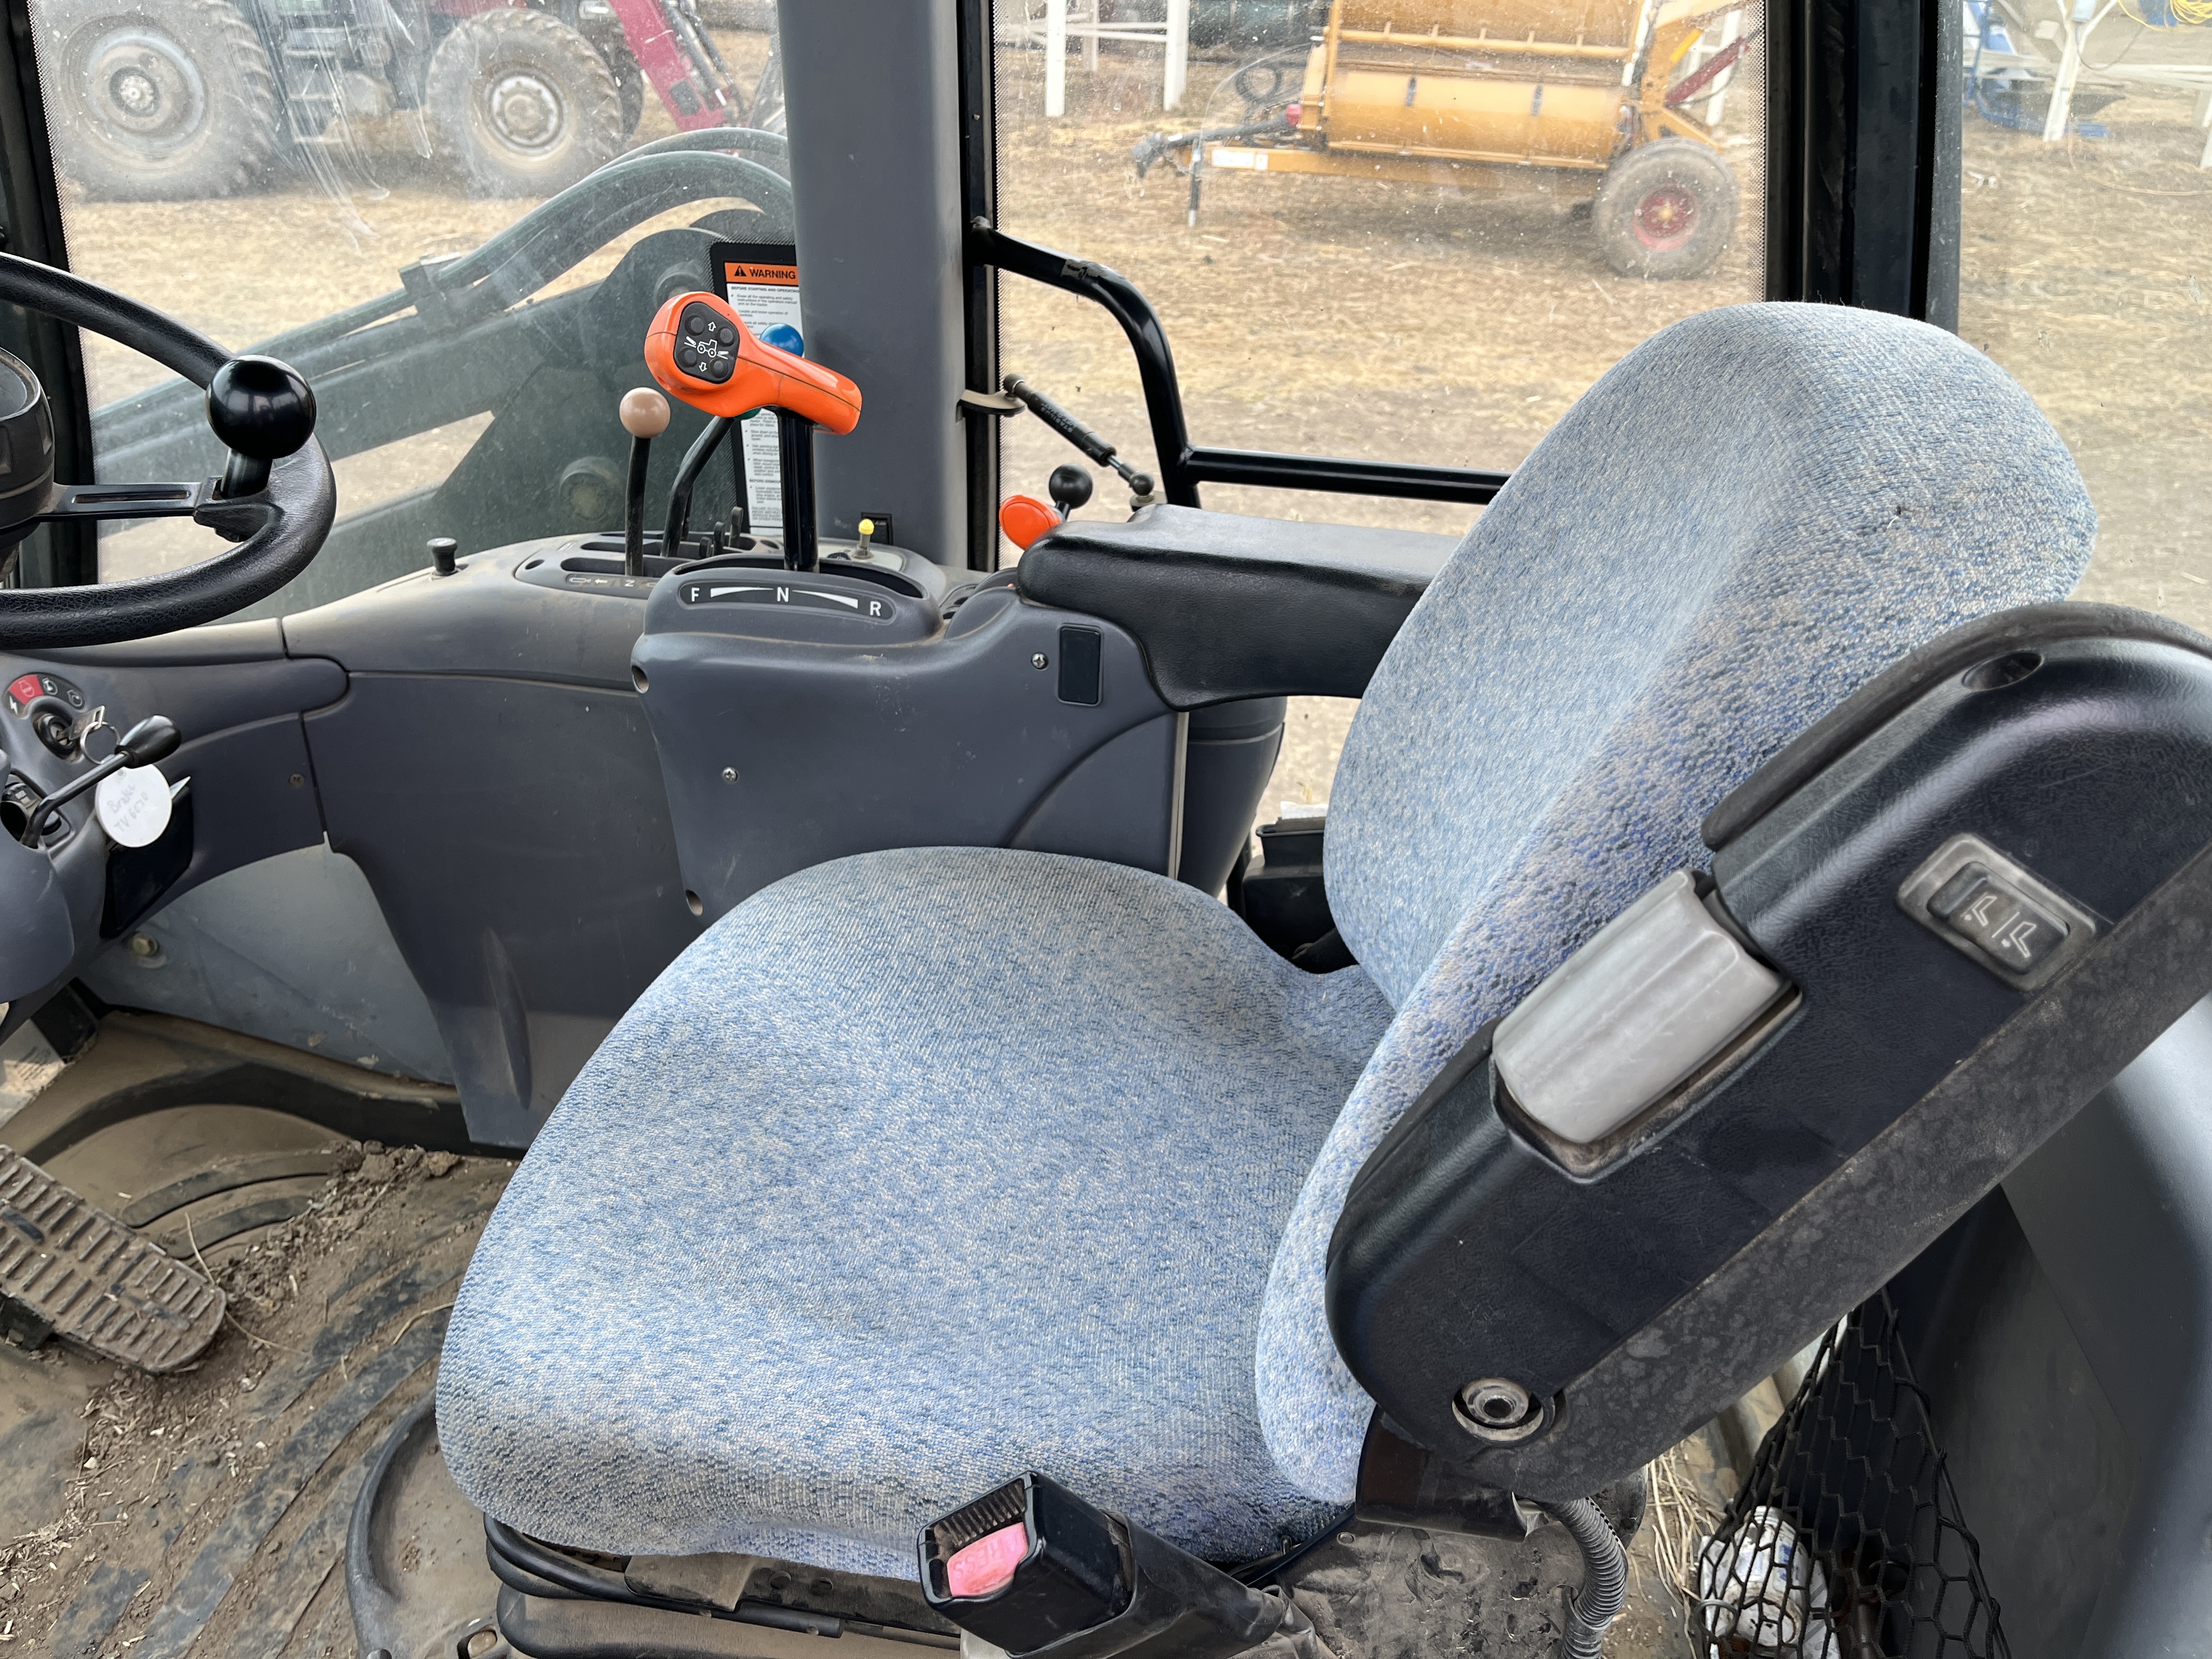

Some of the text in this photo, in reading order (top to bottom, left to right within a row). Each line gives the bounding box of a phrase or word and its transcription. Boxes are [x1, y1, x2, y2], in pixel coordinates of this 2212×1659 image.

[749, 268, 796, 279] WARNING
[691, 586, 882, 617] F N R
[953, 1530, 1017, 1578] PRESS
